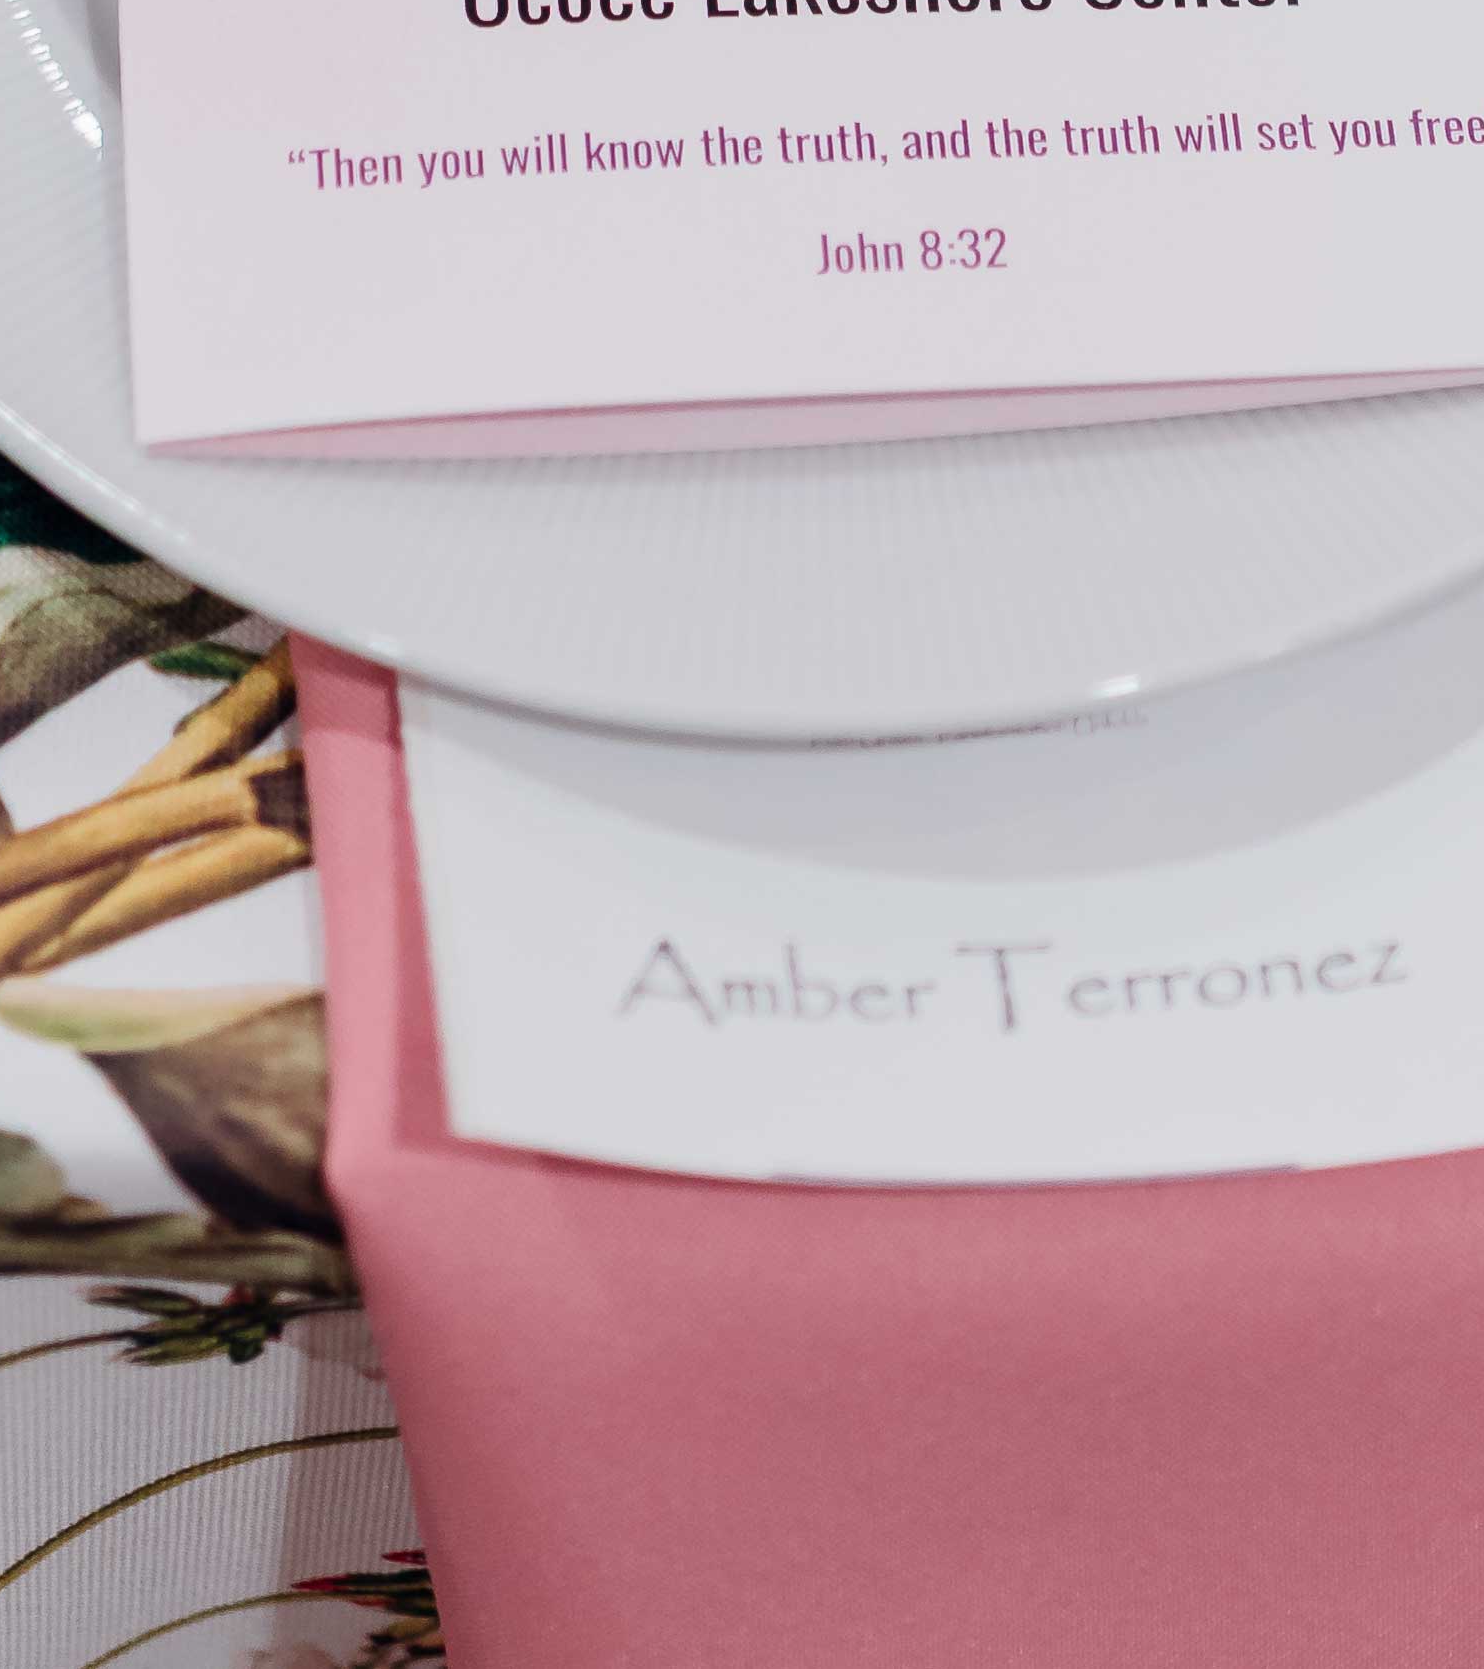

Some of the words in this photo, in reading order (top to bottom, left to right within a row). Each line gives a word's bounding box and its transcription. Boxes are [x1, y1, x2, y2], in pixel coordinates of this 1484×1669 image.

[417, 149, 485, 189] you
[500, 132, 569, 176] will
[583, 131, 685, 172] know
[700, 125, 763, 167] the
[776, 121, 888, 167] truth,
[902, 118, 971, 161] and
[984, 117, 1048, 159] the
[1061, 114, 1161, 157] truth
[1174, 112, 1243, 153] will
[1256, 113, 1317, 151] set
[1327, 118, 1397, 156] you
[817, 231, 904, 275] John
[919, 227, 1008, 271] 8:32
[617, 937, 935, 1027] Amber
[955, 939, 1409, 1033] Terronez
